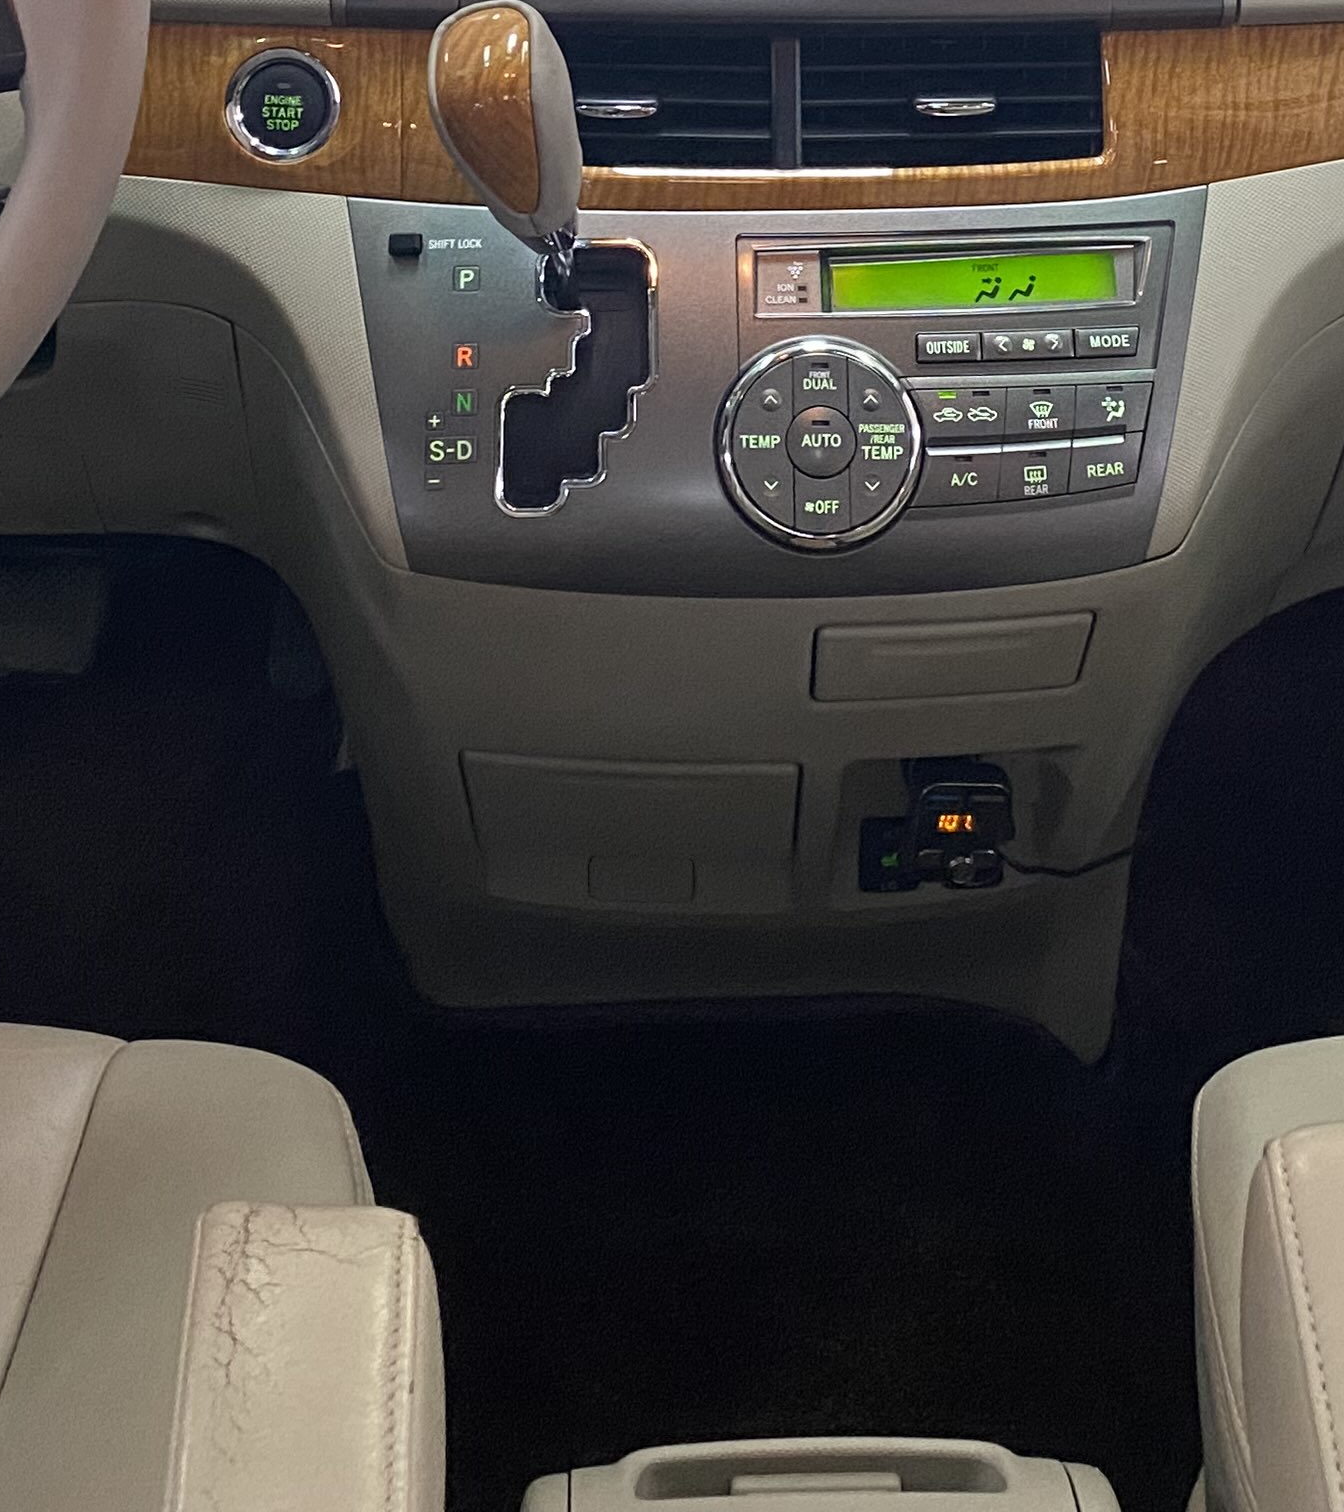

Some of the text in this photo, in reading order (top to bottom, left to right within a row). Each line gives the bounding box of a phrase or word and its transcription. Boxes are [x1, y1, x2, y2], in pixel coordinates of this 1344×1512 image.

[264, 95, 302, 105] ENGINE
[262, 107, 304, 119] START
[266, 119, 299, 131] STOP
[428, 238, 482, 249] SHIFT LOCK
[459, 270, 475, 290] P
[777, 283, 794, 292] ION
[765, 295, 796, 305] CLEAN
[926, 341, 970, 354] OUTSIDE
[1089, 334, 1131, 348] MODE
[456, 347, 472, 367] R
[803, 378, 837, 390] DUAL
[456, 393, 472, 411] N
[858, 423, 905, 434] PASSENGER
[1028, 419, 1059, 429] FRONT
[740, 435, 781, 449] TEMP
[801, 434, 842, 448] AUTO
[861, 446, 904, 460] TEMP
[1087, 462, 1124, 477] REAR
[951, 472, 978, 486] A/C
[1024, 484, 1049, 495] REAR
[815, 500, 840, 514] OFF
